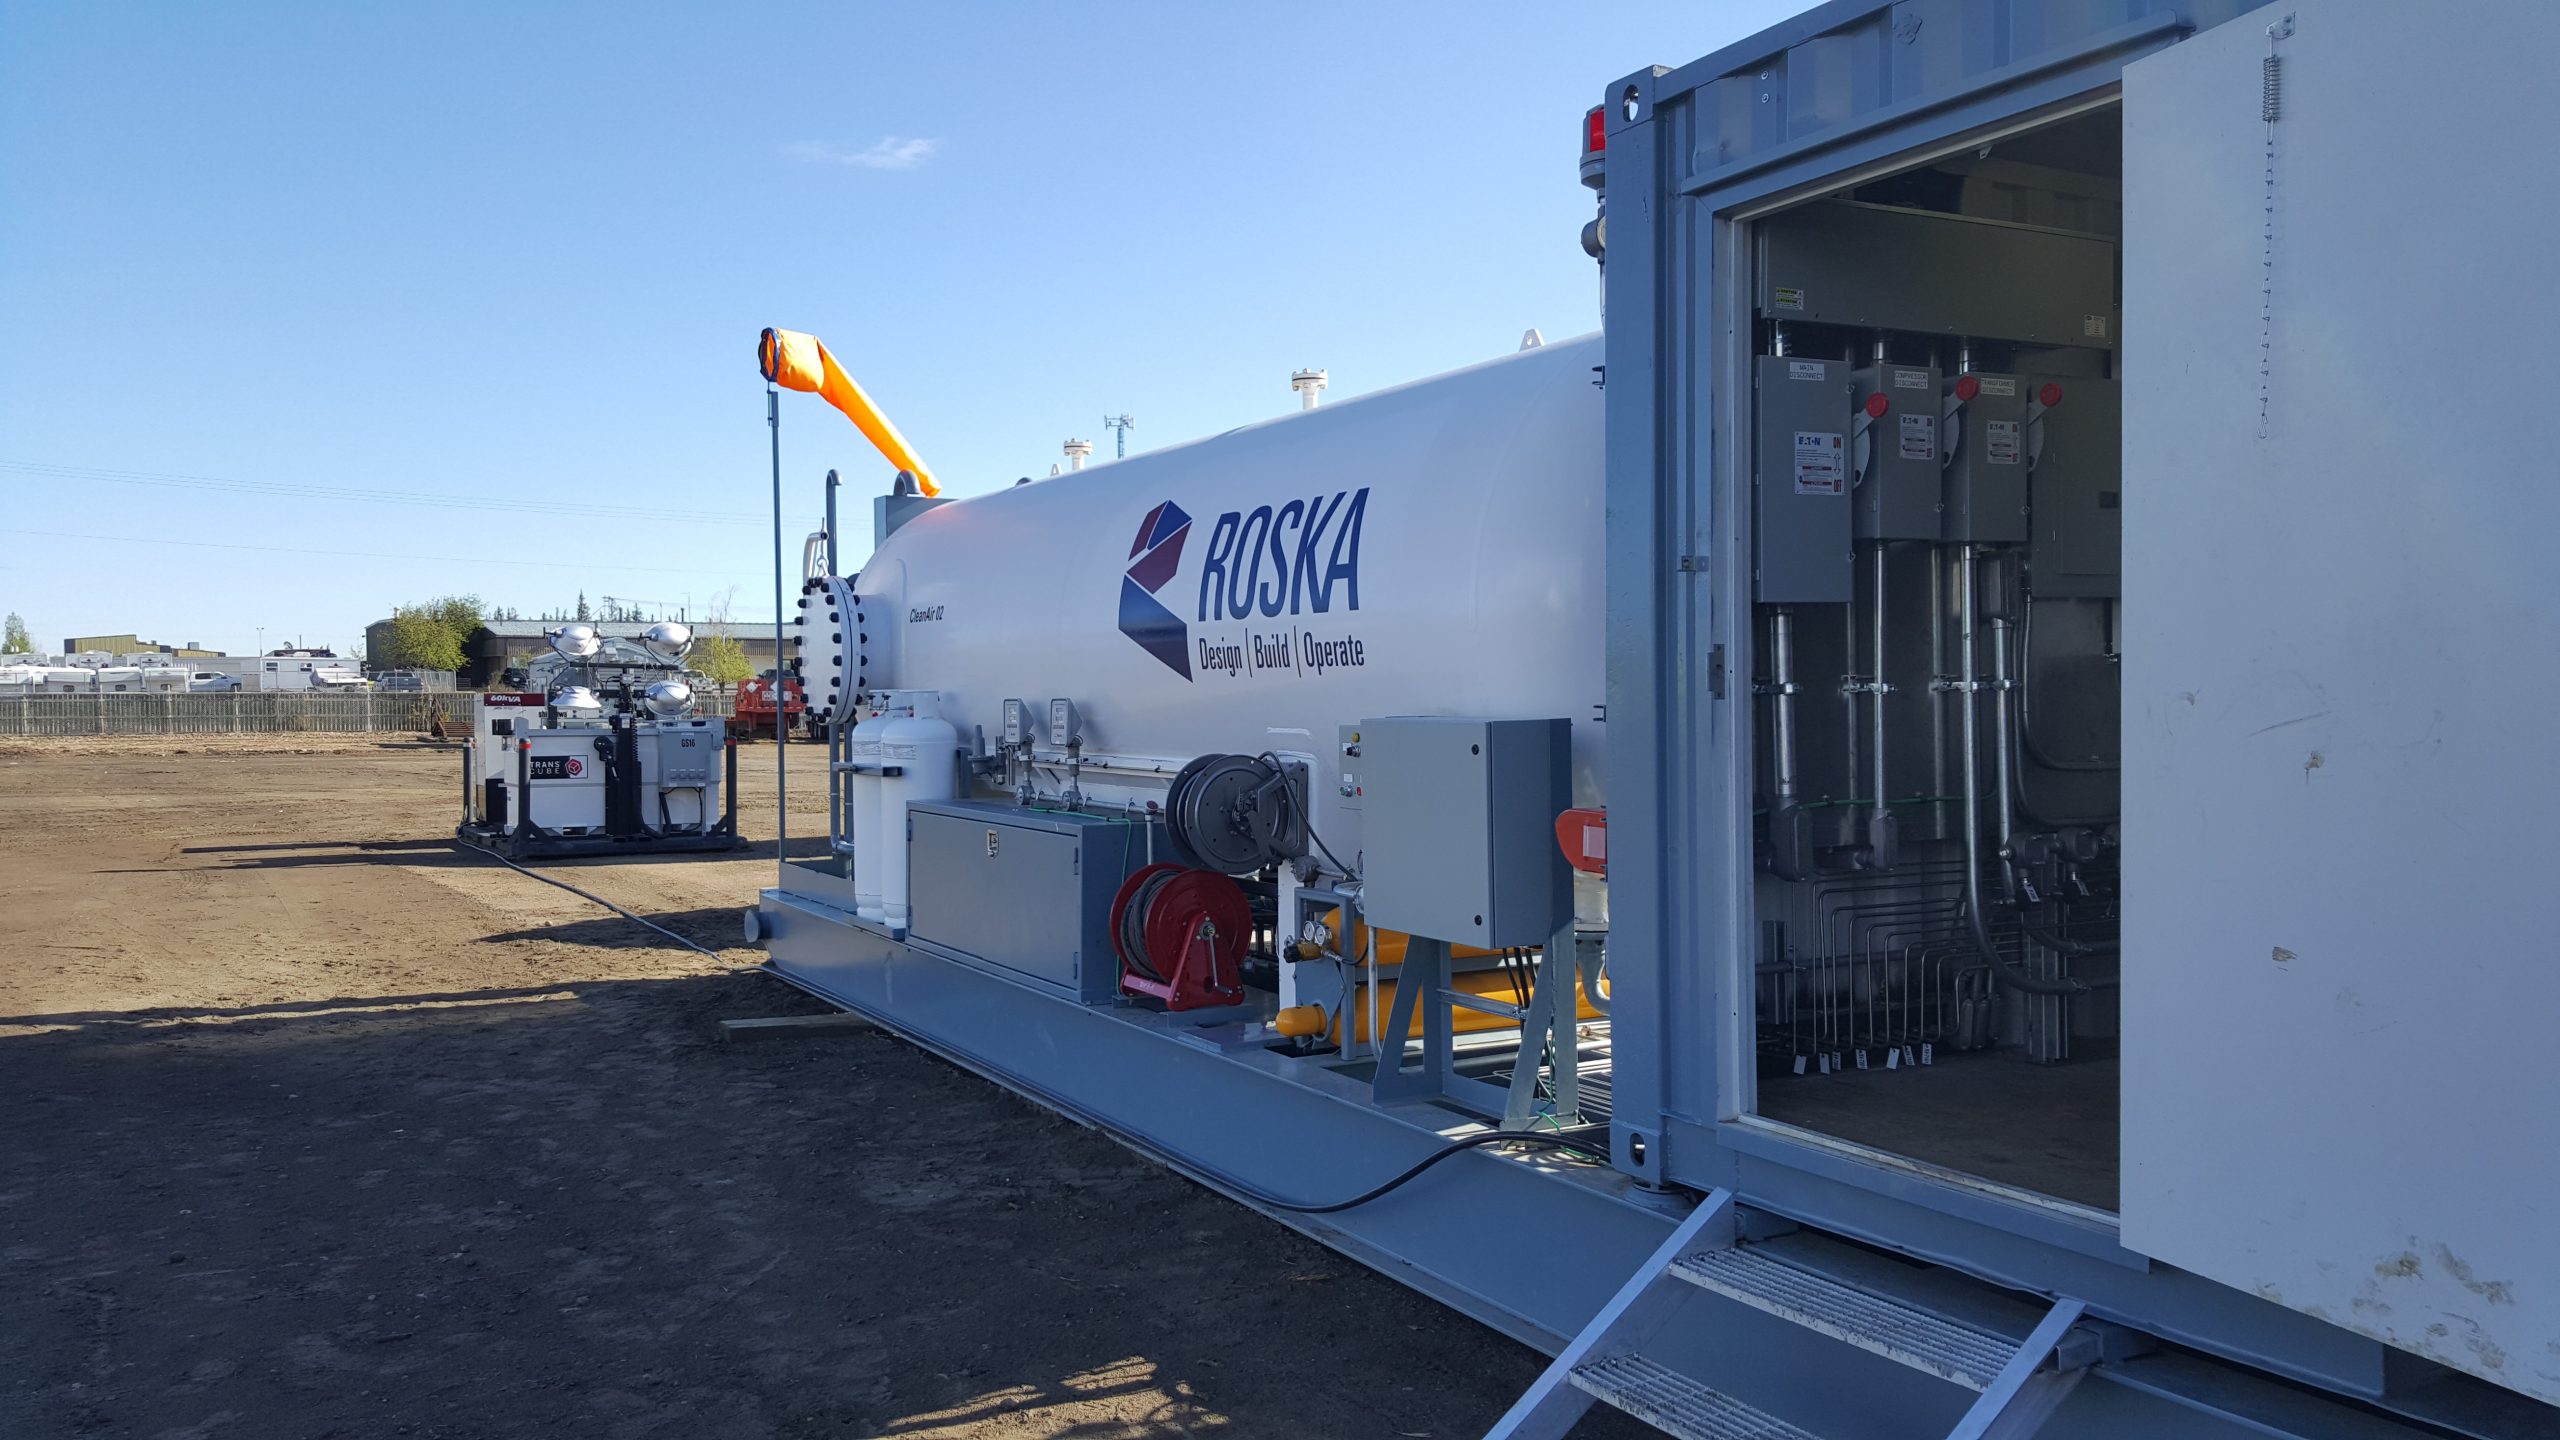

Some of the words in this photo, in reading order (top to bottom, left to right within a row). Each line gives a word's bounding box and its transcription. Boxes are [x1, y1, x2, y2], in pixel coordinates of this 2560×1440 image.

[1198, 487, 1370, 622] ROSKA
[936, 605, 944, 620] 02
[1199, 637, 1243, 677] Design
[1254, 633, 1290, 669] Build
[1303, 632, 1365, 675] Operate
[681, 738, 696, 748] GS16
